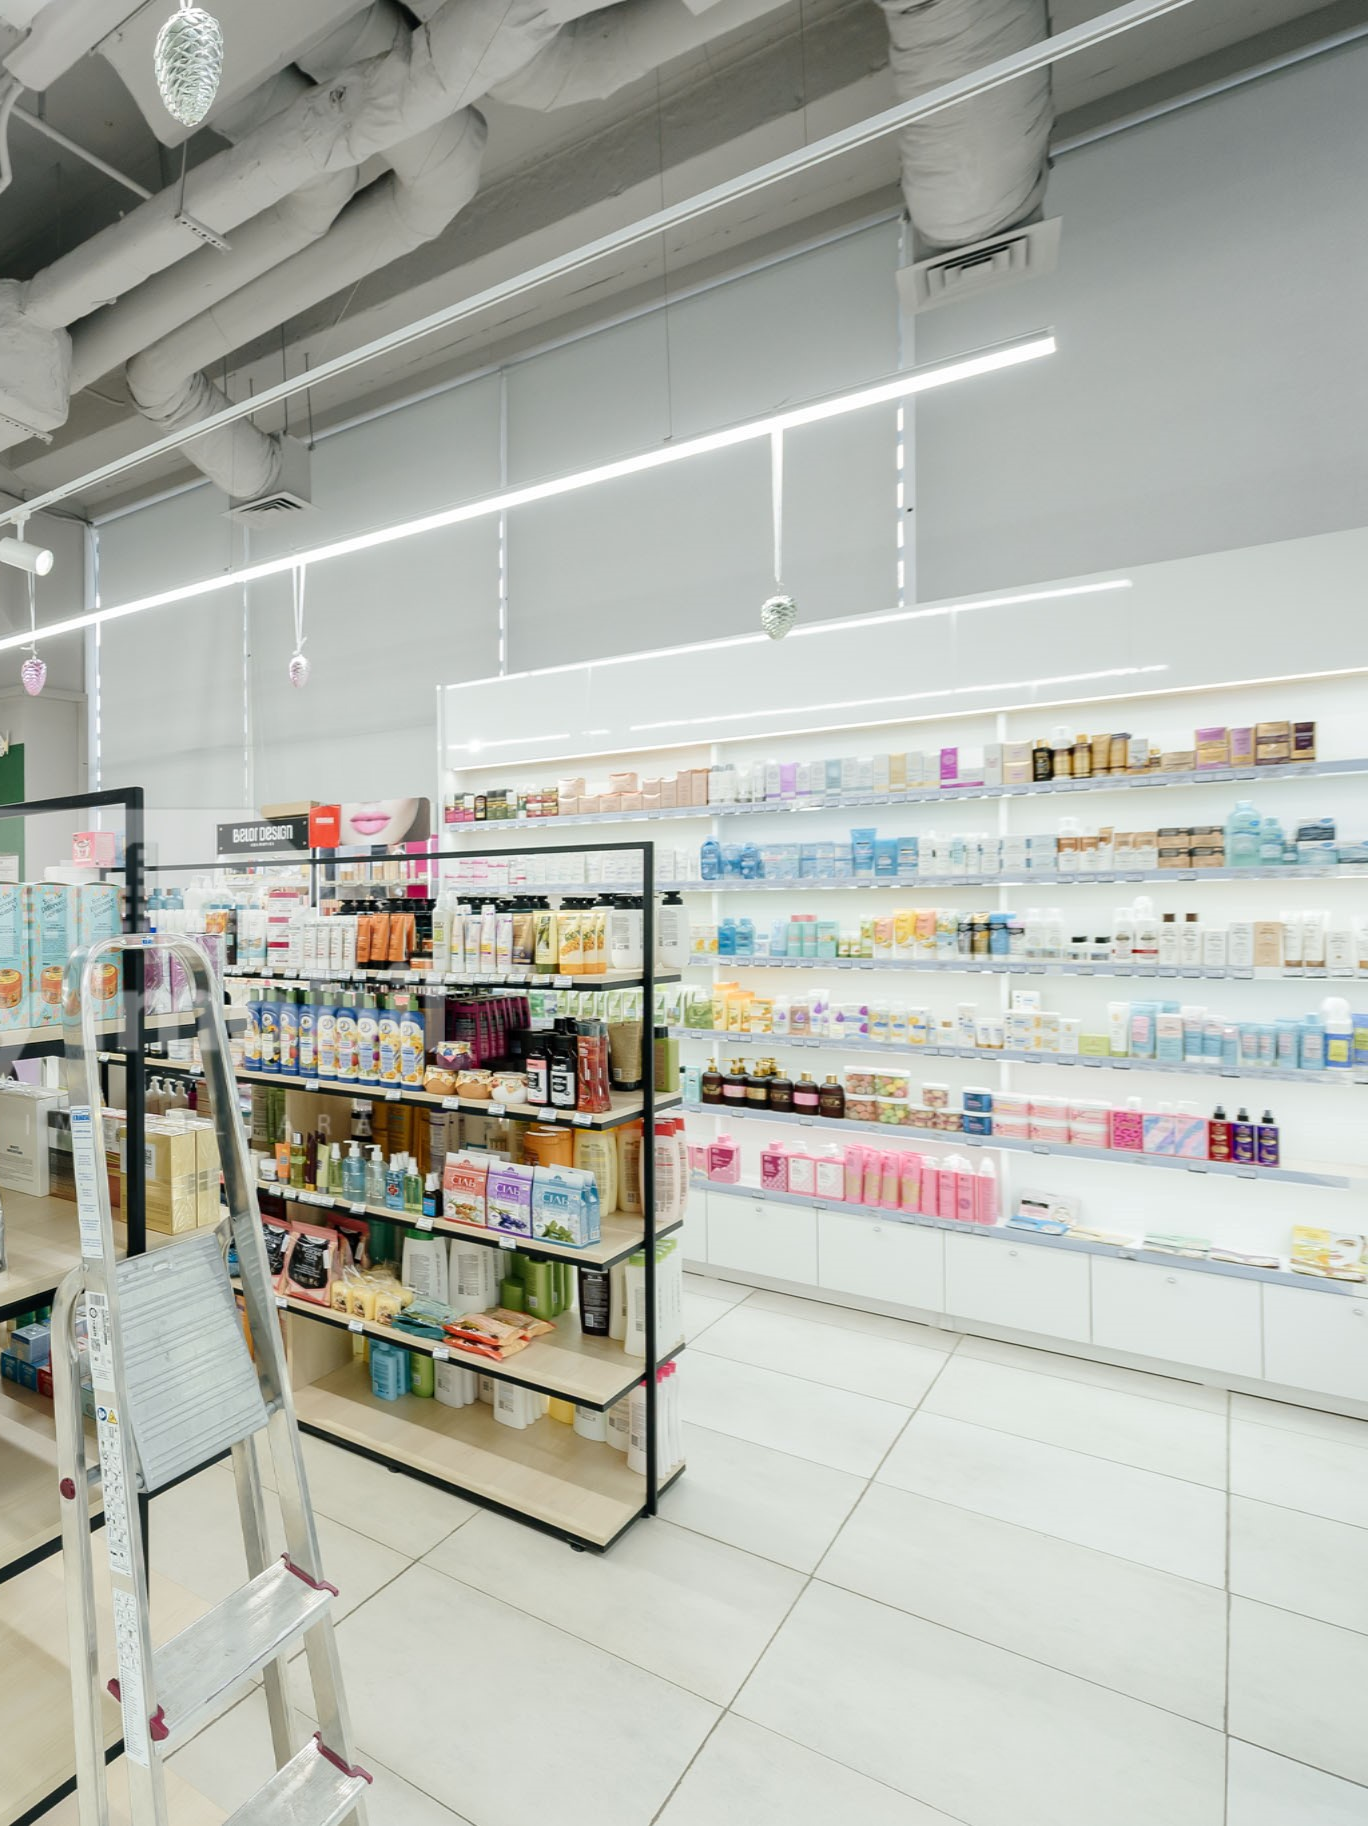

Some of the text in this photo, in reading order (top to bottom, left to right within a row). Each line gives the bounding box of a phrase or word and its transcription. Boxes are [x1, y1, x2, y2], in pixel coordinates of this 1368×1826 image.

[451, 1175, 477, 1188] СІЛЬ
[495, 1183, 521, 1196] СІЛЬ
[542, 1192, 570, 1206] СІЛЬ
